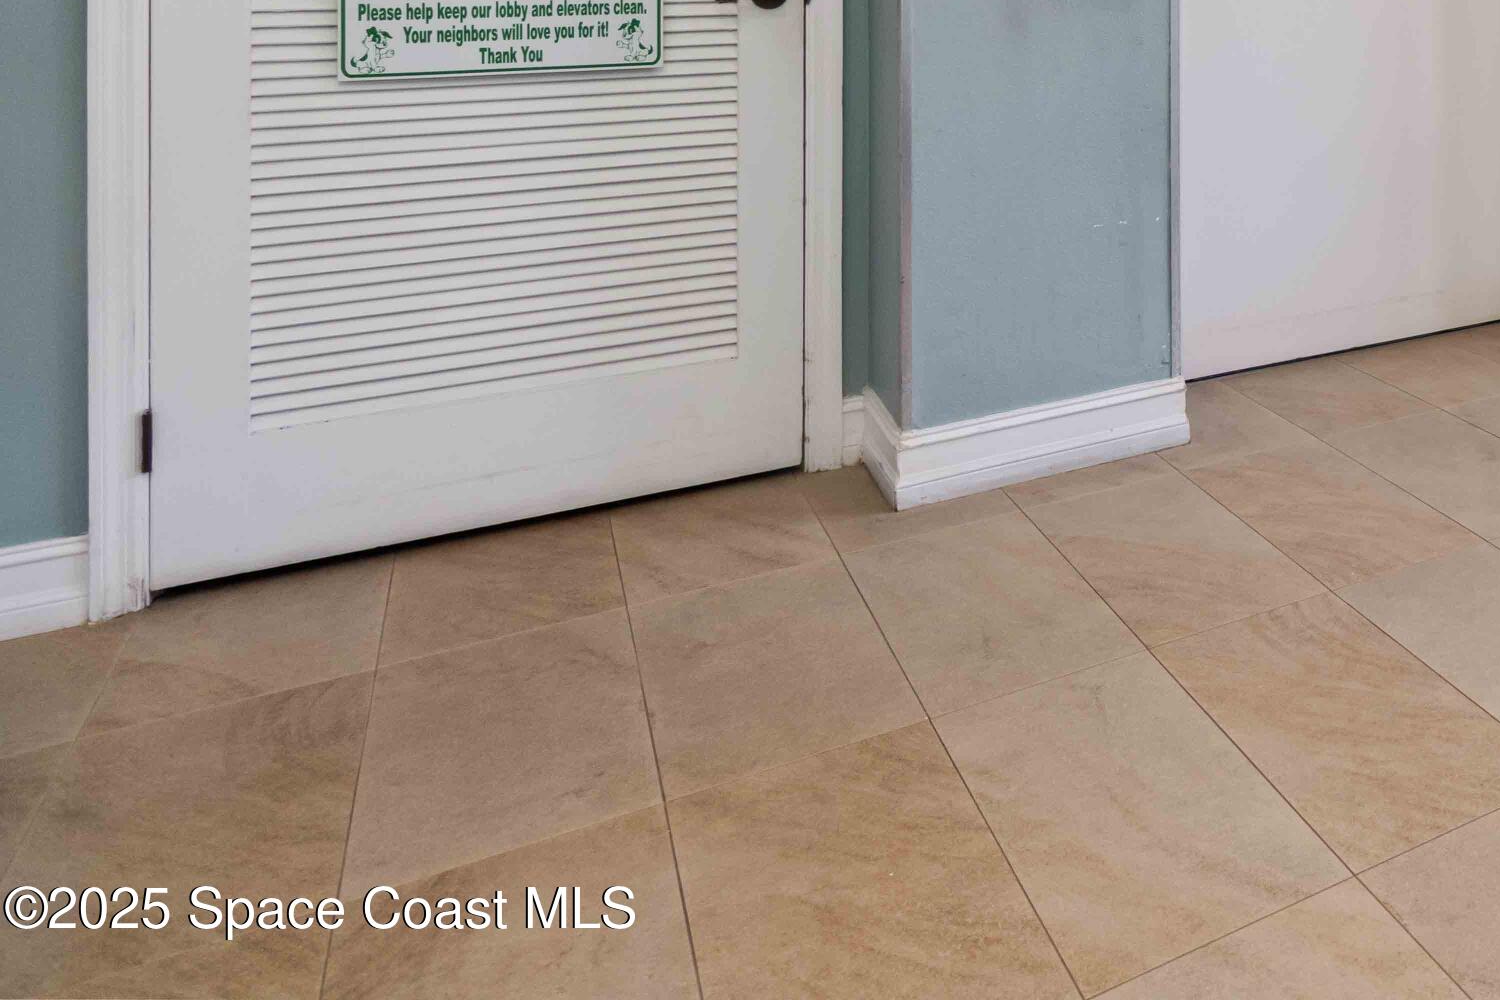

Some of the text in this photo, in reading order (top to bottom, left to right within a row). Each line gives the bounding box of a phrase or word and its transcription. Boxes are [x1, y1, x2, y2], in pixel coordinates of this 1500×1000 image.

[358, 3, 402, 21] Please
[406, 2, 433, 24] help
[437, 2, 467, 23] keep
[471, 5, 492, 19] our
[495, 0, 528, 21] lobby
[531, 0, 553, 17] and
[557, 0, 610, 16] elevators
[403, 21, 609, 47] Your neighbors will love you for it!
[479, 46, 543, 64] Thank You
